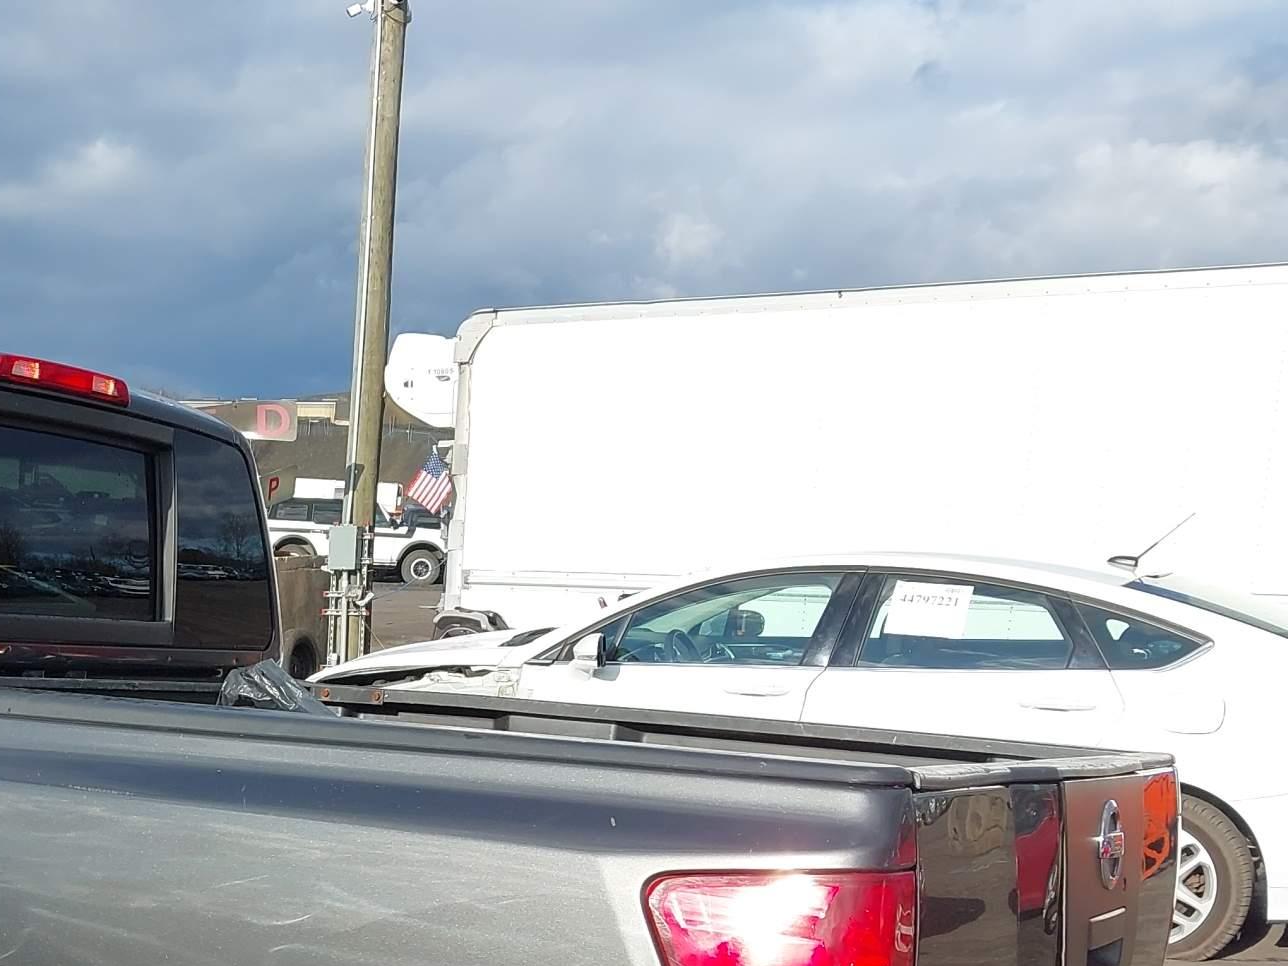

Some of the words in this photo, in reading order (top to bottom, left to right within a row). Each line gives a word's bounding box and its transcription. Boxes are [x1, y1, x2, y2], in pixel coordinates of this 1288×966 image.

[257, 404, 290, 436] D
[268, 477, 280, 501] P
[898, 594, 959, 607] 44797221
